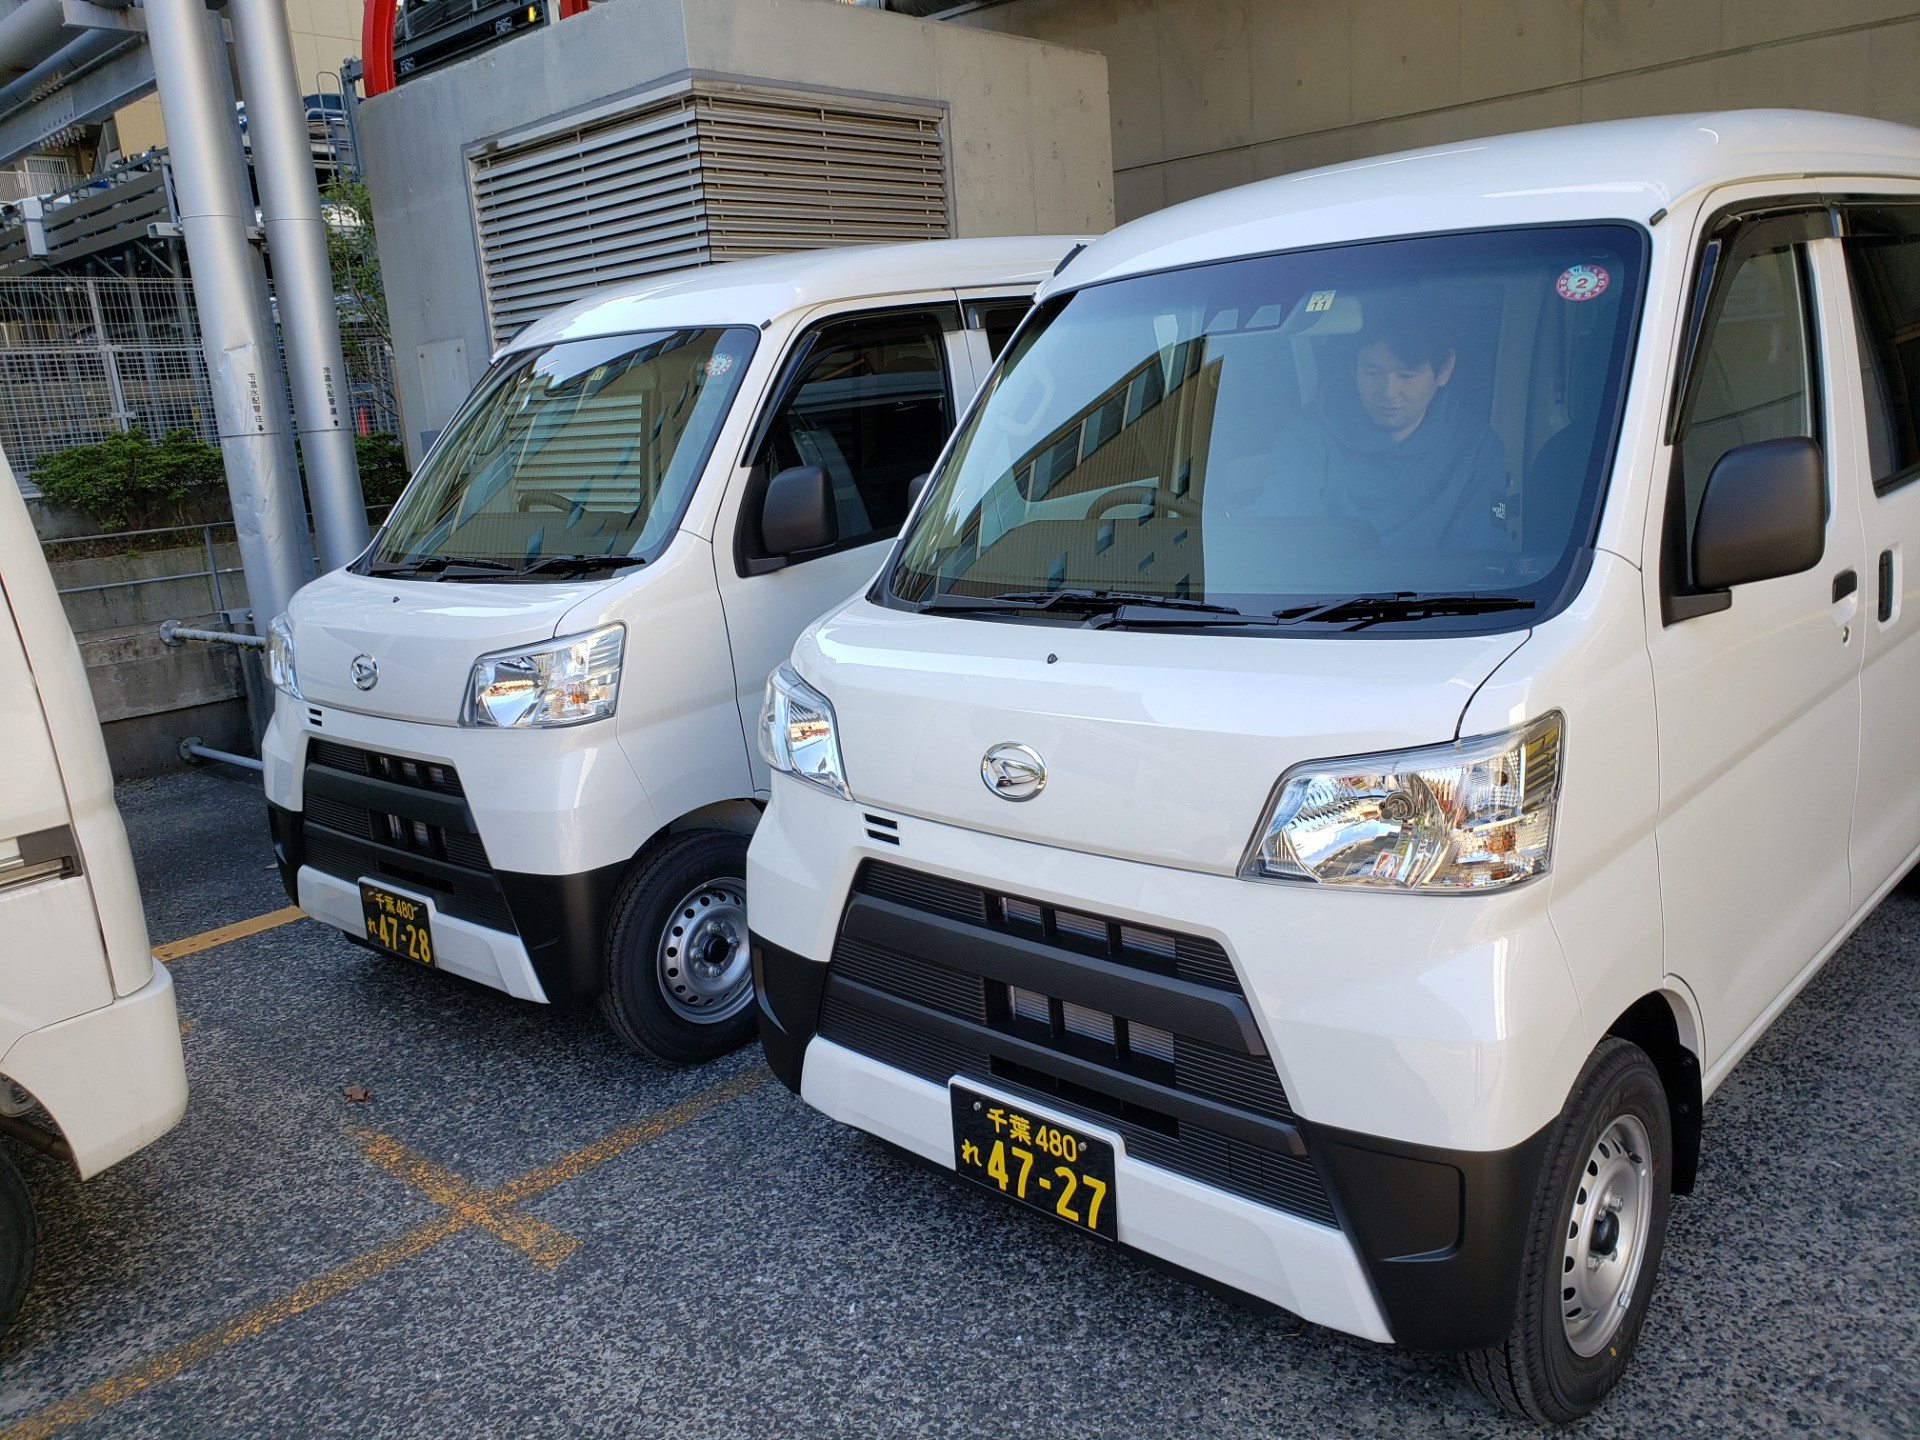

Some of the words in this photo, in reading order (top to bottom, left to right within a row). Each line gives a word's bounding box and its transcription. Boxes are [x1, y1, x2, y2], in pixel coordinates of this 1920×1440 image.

[1575, 277, 1589, 289] 2
[1312, 300, 1327, 310] 11
[375, 893, 395, 915] 千葉
[396, 899, 415, 921] 480
[380, 914, 431, 963] 47-28
[987, 1108, 1031, 1146] 千葉
[1035, 1125, 1077, 1162] 480
[961, 1138, 983, 1167] れ
[987, 1140, 1107, 1230] 47-27
